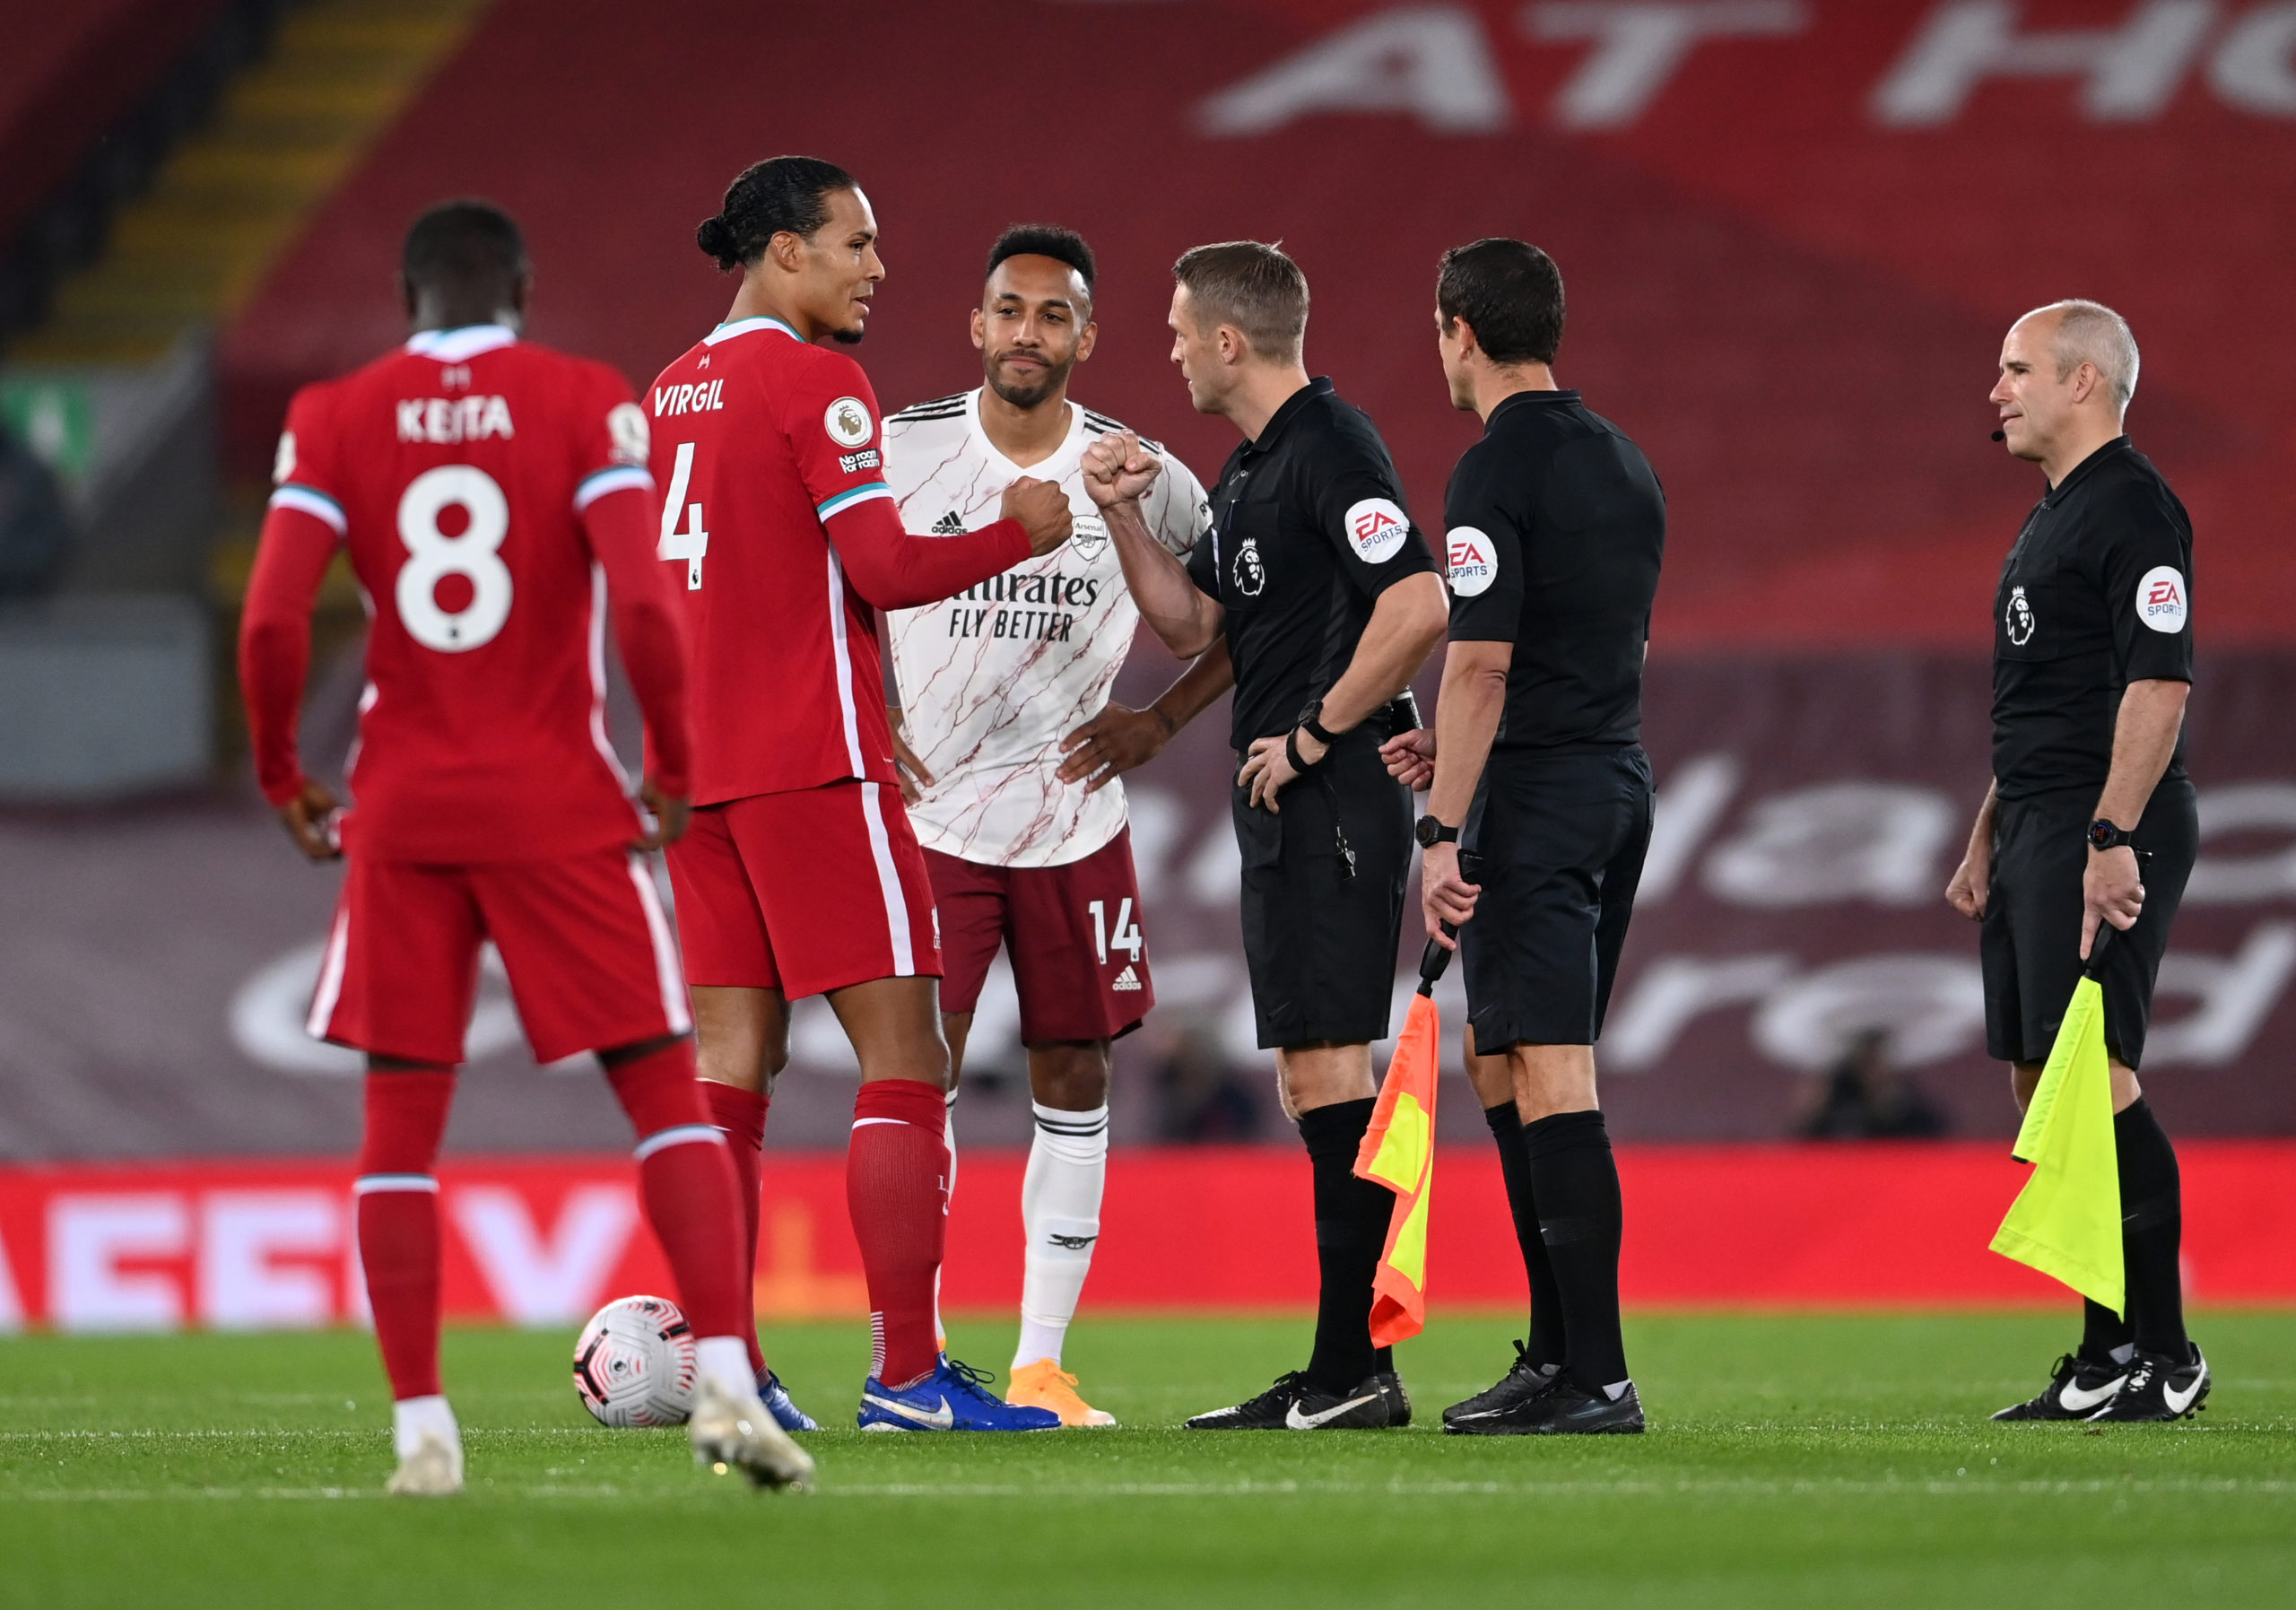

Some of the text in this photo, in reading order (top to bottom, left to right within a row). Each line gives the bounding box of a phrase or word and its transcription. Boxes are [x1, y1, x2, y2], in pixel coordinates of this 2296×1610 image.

[1200, 0, 1807, 135] AT
[655, 379, 724, 417] VIRGIL
[396, 394, 516, 445] KEITA
[656, 441, 709, 591] 4
[931, 525, 968, 535] adidas
[1075, 522, 1102, 532] Arsenal
[1355, 511, 1397, 542] EA
[1361, 525, 1404, 553] SPORTS
[396, 463, 514, 654] 8
[1449, 543, 1485, 567] EA
[1450, 565, 1488, 579] SPORTS
[2148, 581, 2180, 605] EA
[949, 608, 1074, 642] FLY BETTER
[2148, 604, 2182, 617] SPORTS
[1089, 897, 1143, 965] 14
[1112, 982, 1143, 991] adidas
